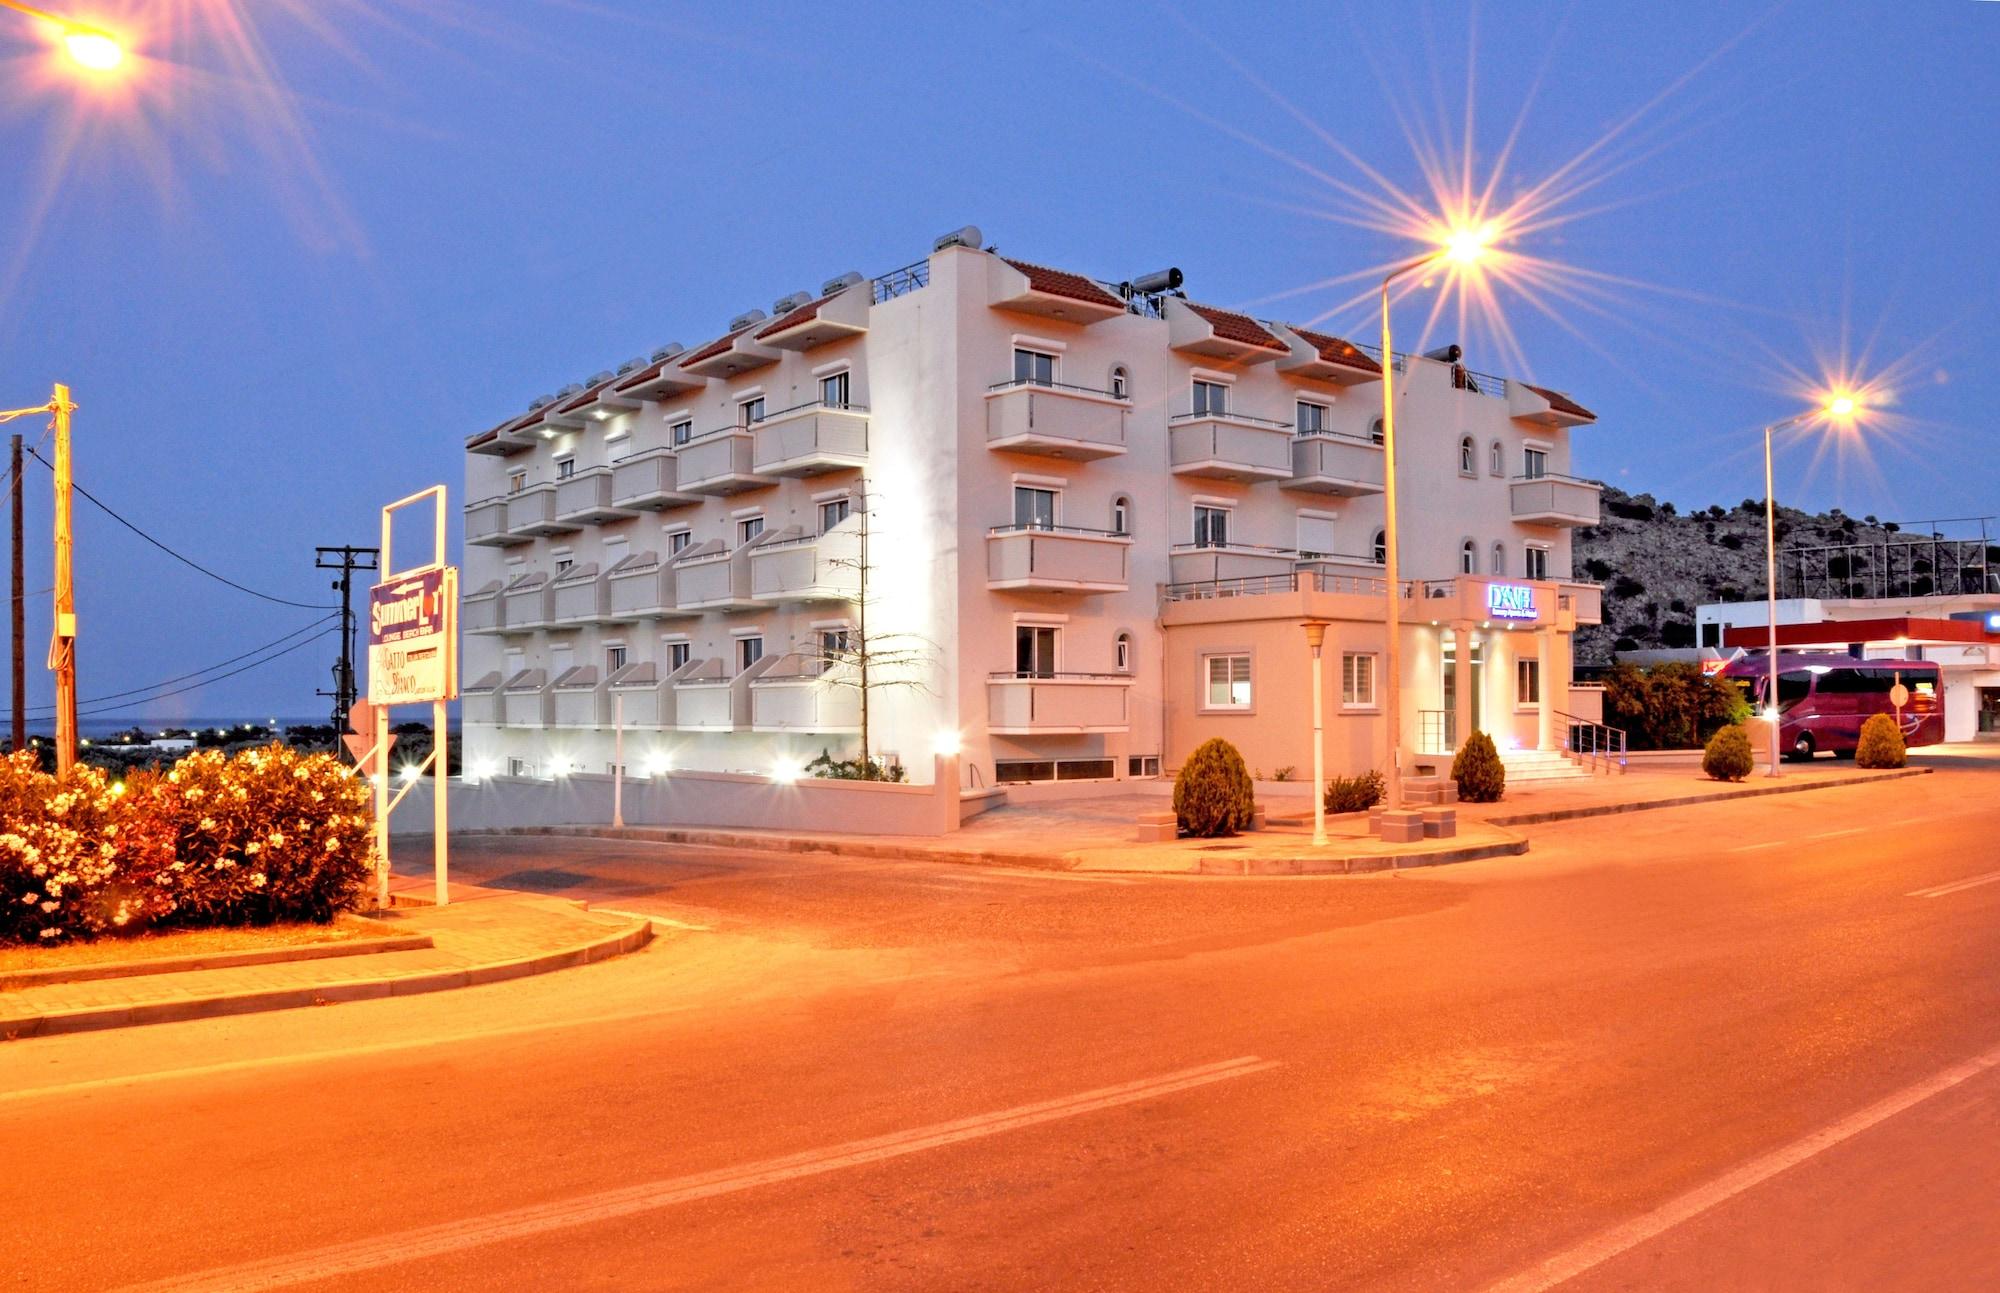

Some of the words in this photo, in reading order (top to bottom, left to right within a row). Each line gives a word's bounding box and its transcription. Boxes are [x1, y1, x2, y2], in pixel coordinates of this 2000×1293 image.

[402, 627, 419, 639] BEACH
[419, 624, 434, 636] BAR
[383, 647, 405, 671] GATTO
